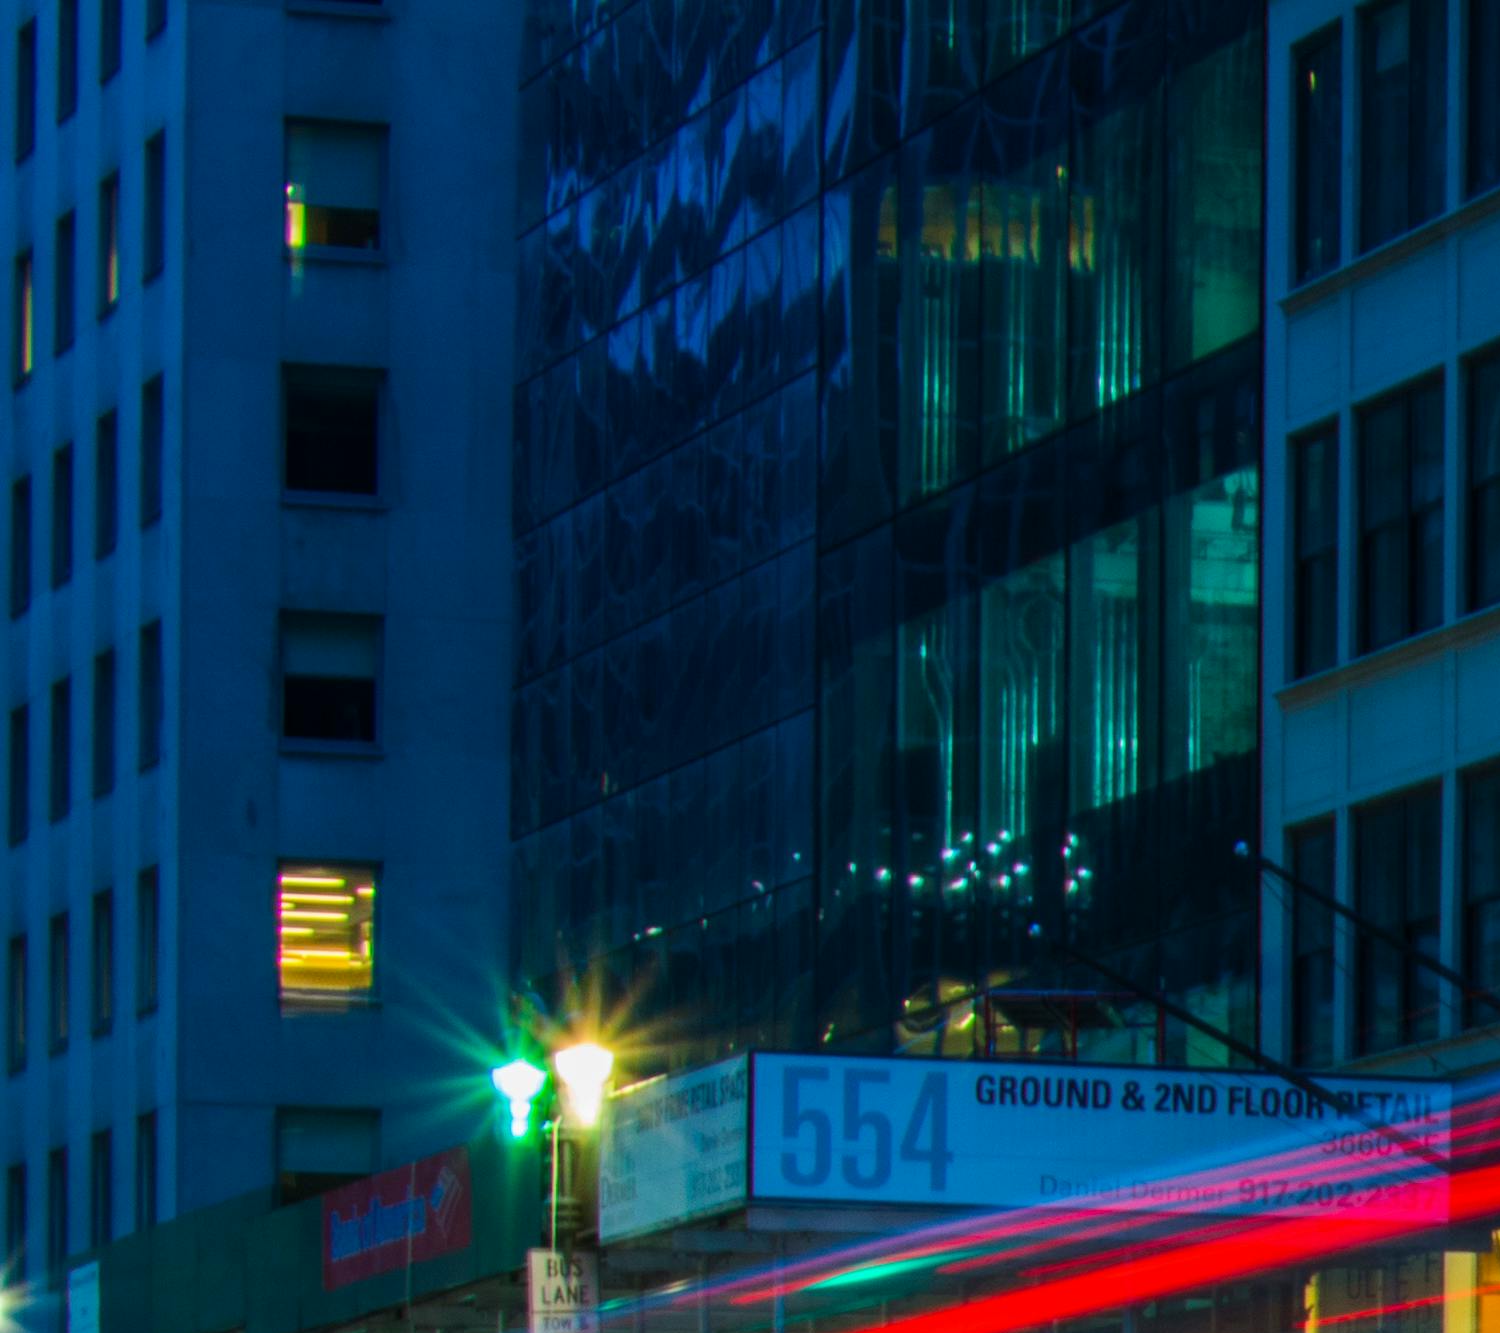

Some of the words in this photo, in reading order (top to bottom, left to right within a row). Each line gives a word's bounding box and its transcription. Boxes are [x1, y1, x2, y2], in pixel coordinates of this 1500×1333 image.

[976, 1074, 1111, 1111] GROUND
[1121, 1081, 1146, 1111] &
[1154, 1083, 1217, 1115] 2ND
[1227, 1087, 1325, 1120] FLOOR
[1335, 1091, 1441, 1124] RETAIL
[779, 1066, 953, 1196] 554
[1039, 1174, 1121, 1201] Daniel
[546, 1258, 584, 1278] BUS
[541, 1284, 590, 1306] LANE
[542, 1316, 572, 1330] TOW
